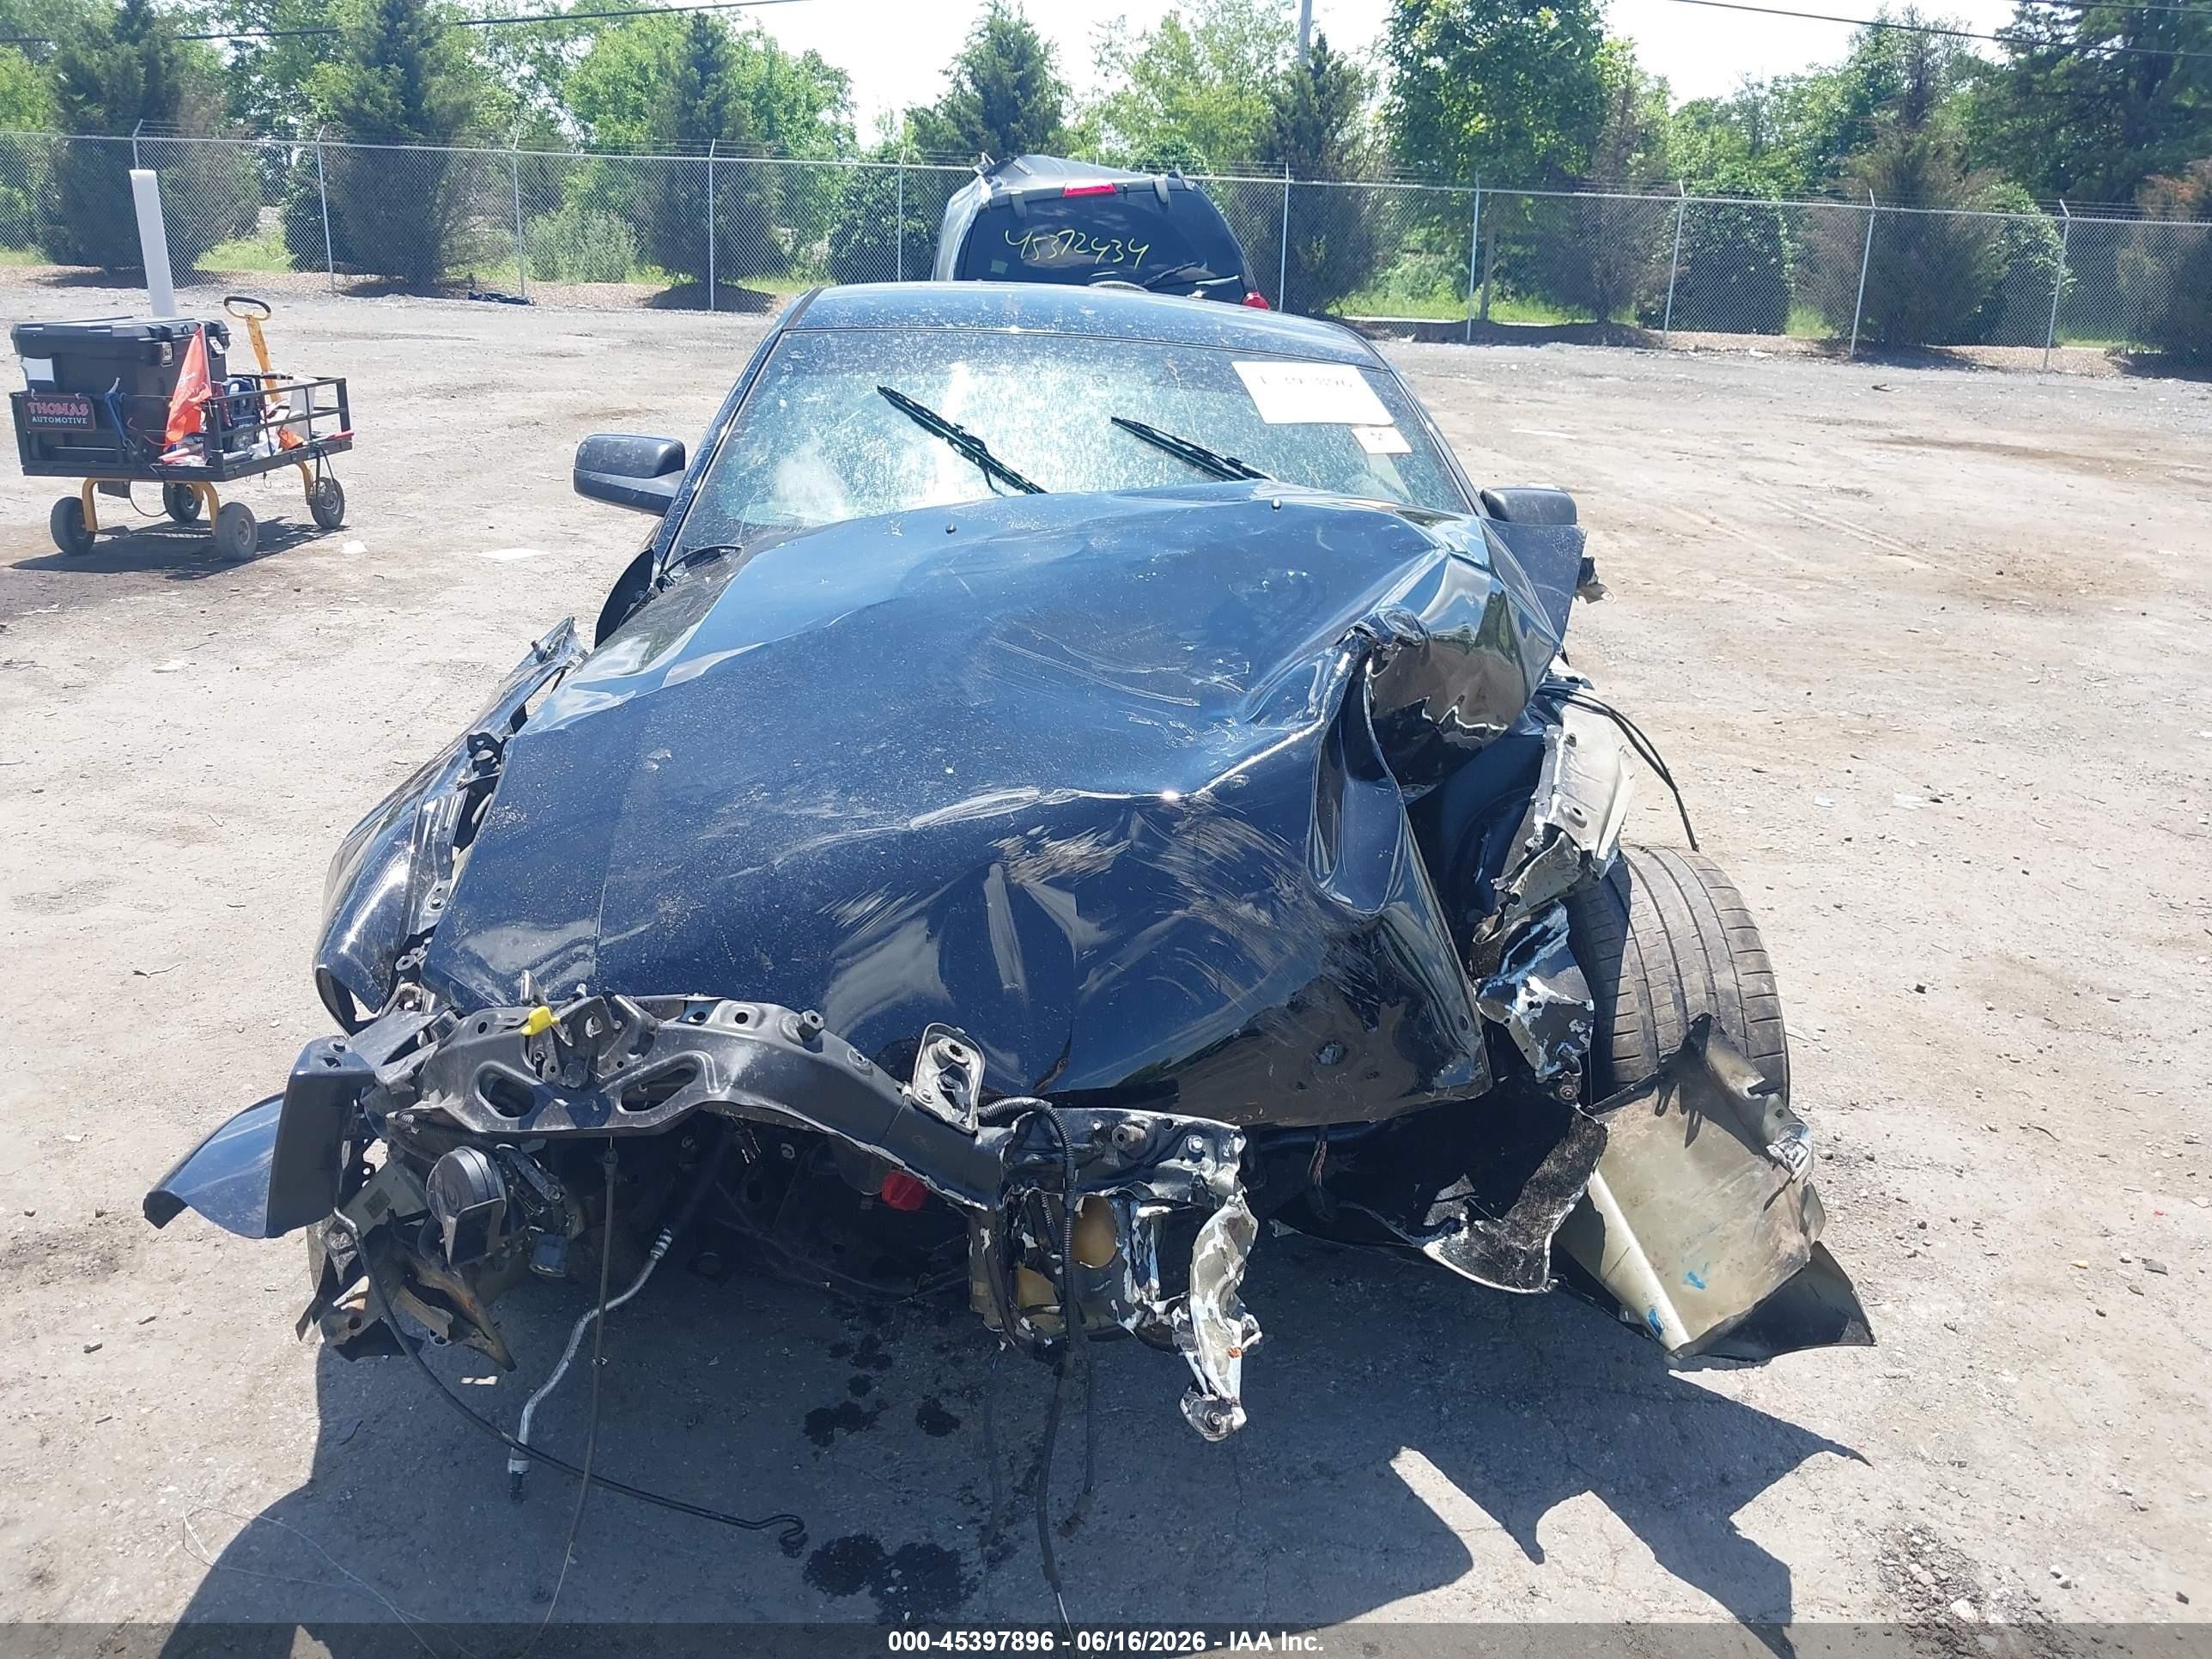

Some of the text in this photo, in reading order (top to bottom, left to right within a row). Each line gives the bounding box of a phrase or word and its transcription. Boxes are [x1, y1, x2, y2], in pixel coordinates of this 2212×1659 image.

[1005, 229, 1150, 270] 45372434
[27, 402, 89, 416] THOMAS
[32, 416, 88, 424] AUTOMOTIVE
